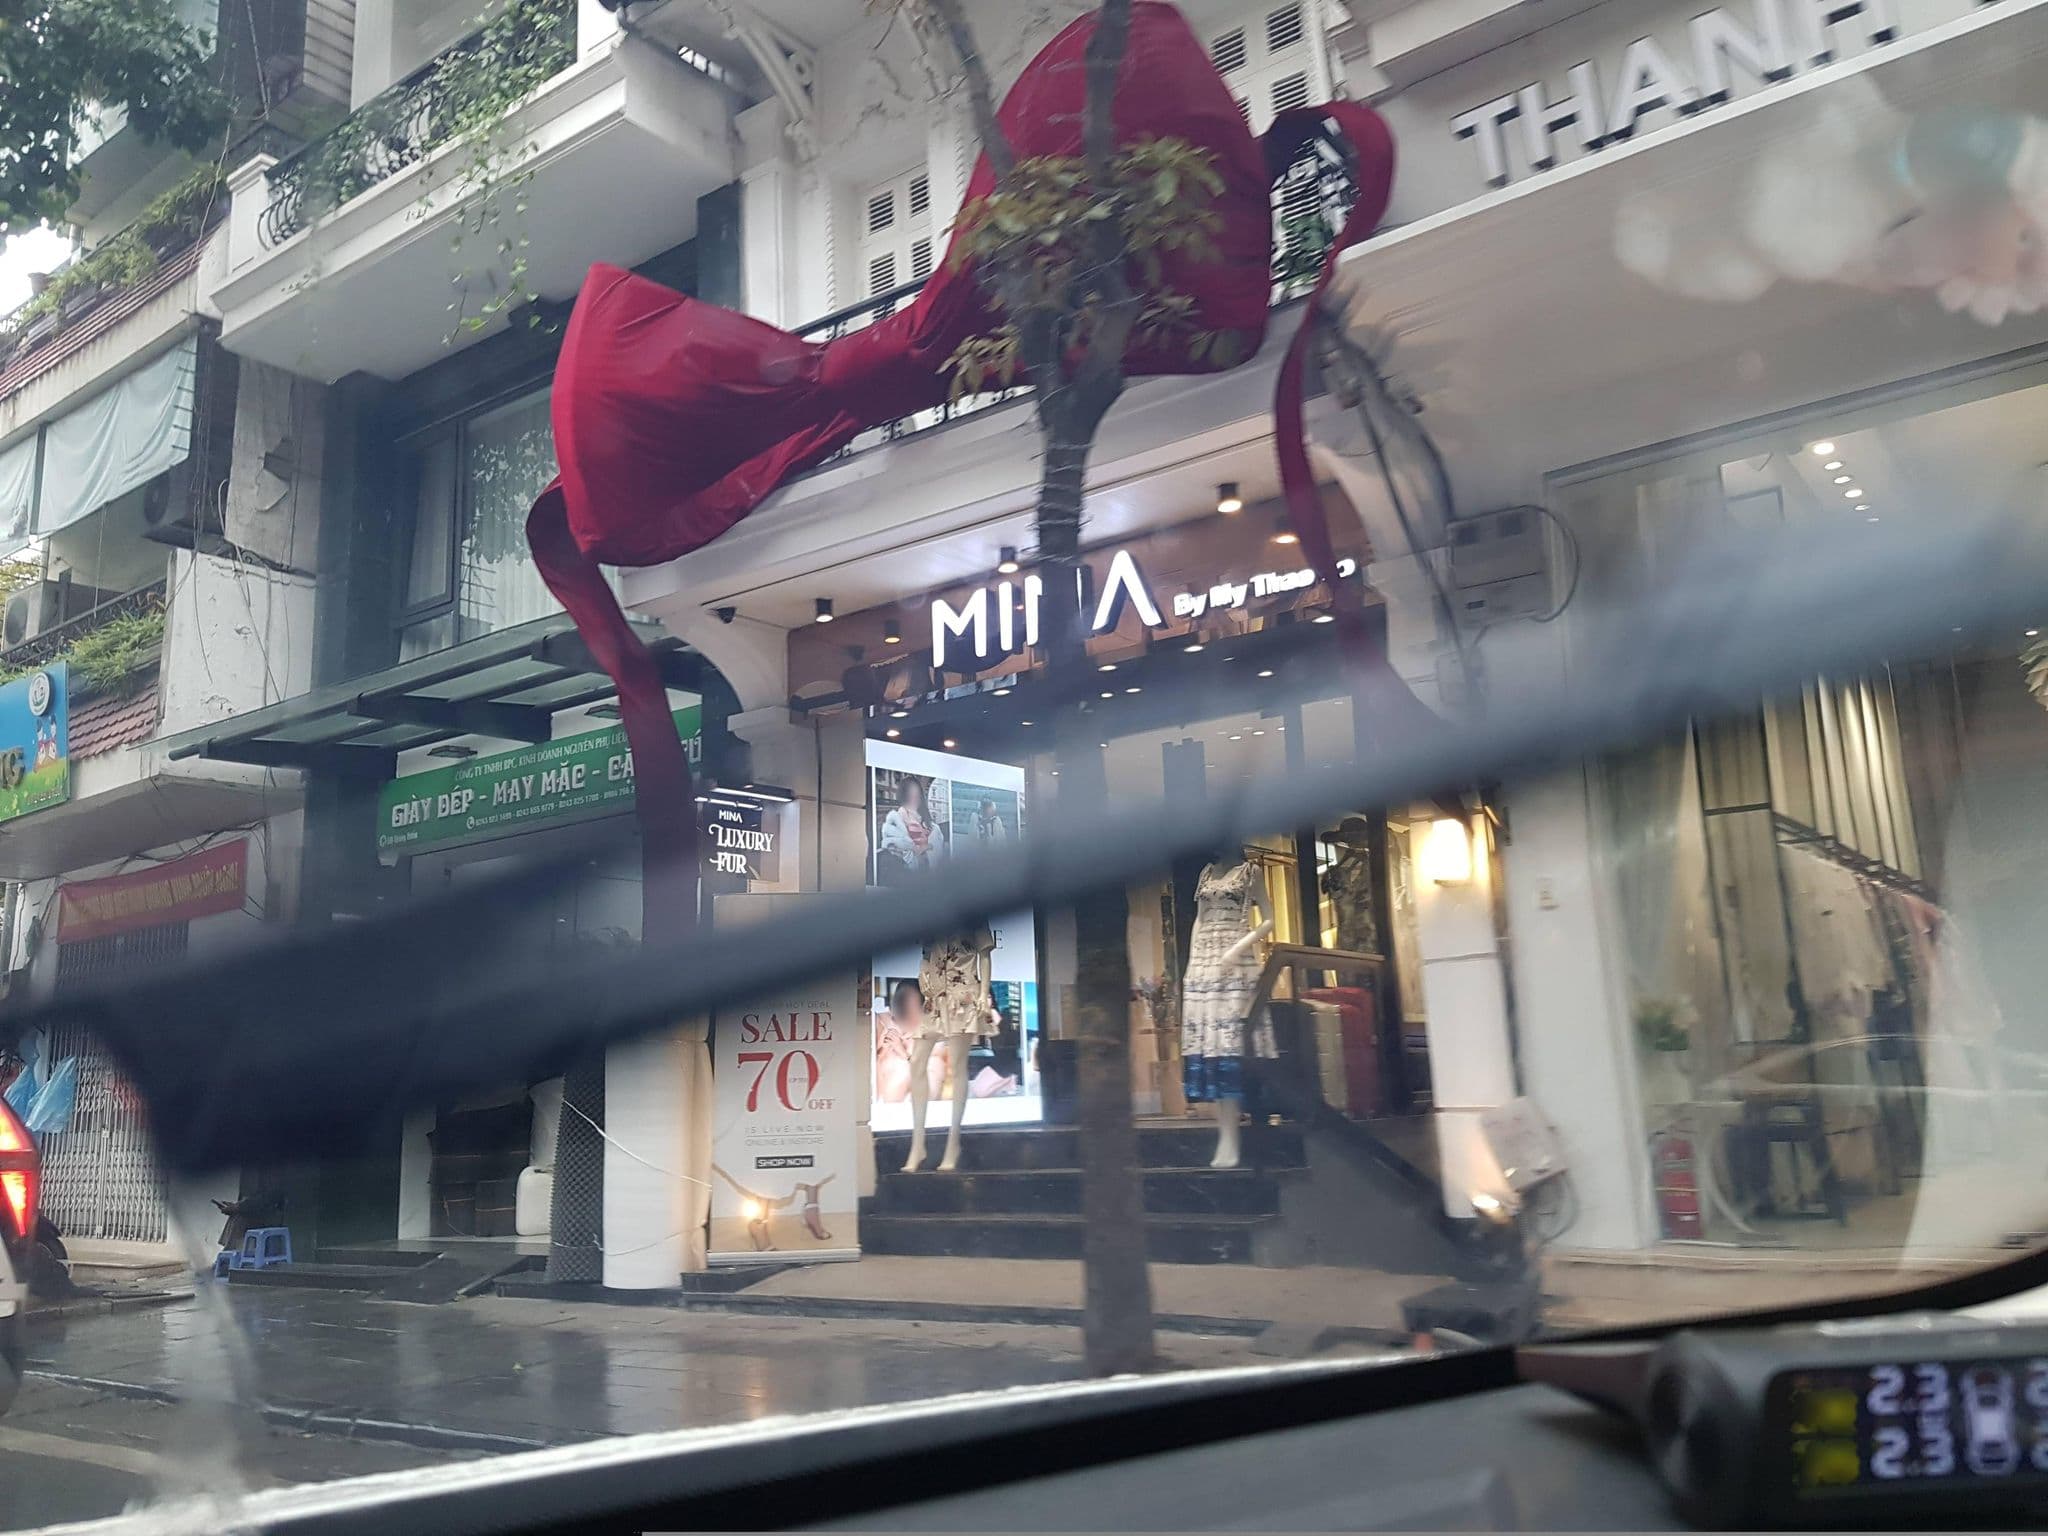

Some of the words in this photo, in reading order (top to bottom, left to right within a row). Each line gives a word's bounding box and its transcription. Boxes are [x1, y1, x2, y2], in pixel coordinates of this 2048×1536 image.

[1173, 592, 1208, 617] By
[392, 794, 432, 828] GIÀY
[492, 774, 535, 806] MAY
[540, 760, 586, 799] MẶC
[718, 809, 744, 823] MINA
[708, 824, 775, 852] LUXURY
[709, 851, 748, 874] FUR
[741, 1011, 833, 1044] SALE
[737, 1049, 820, 1112] 70
[808, 1098, 835, 1110] OFF
[757, 1158, 786, 1168] SHOP
[786, 1157, 813, 1167] NOW
